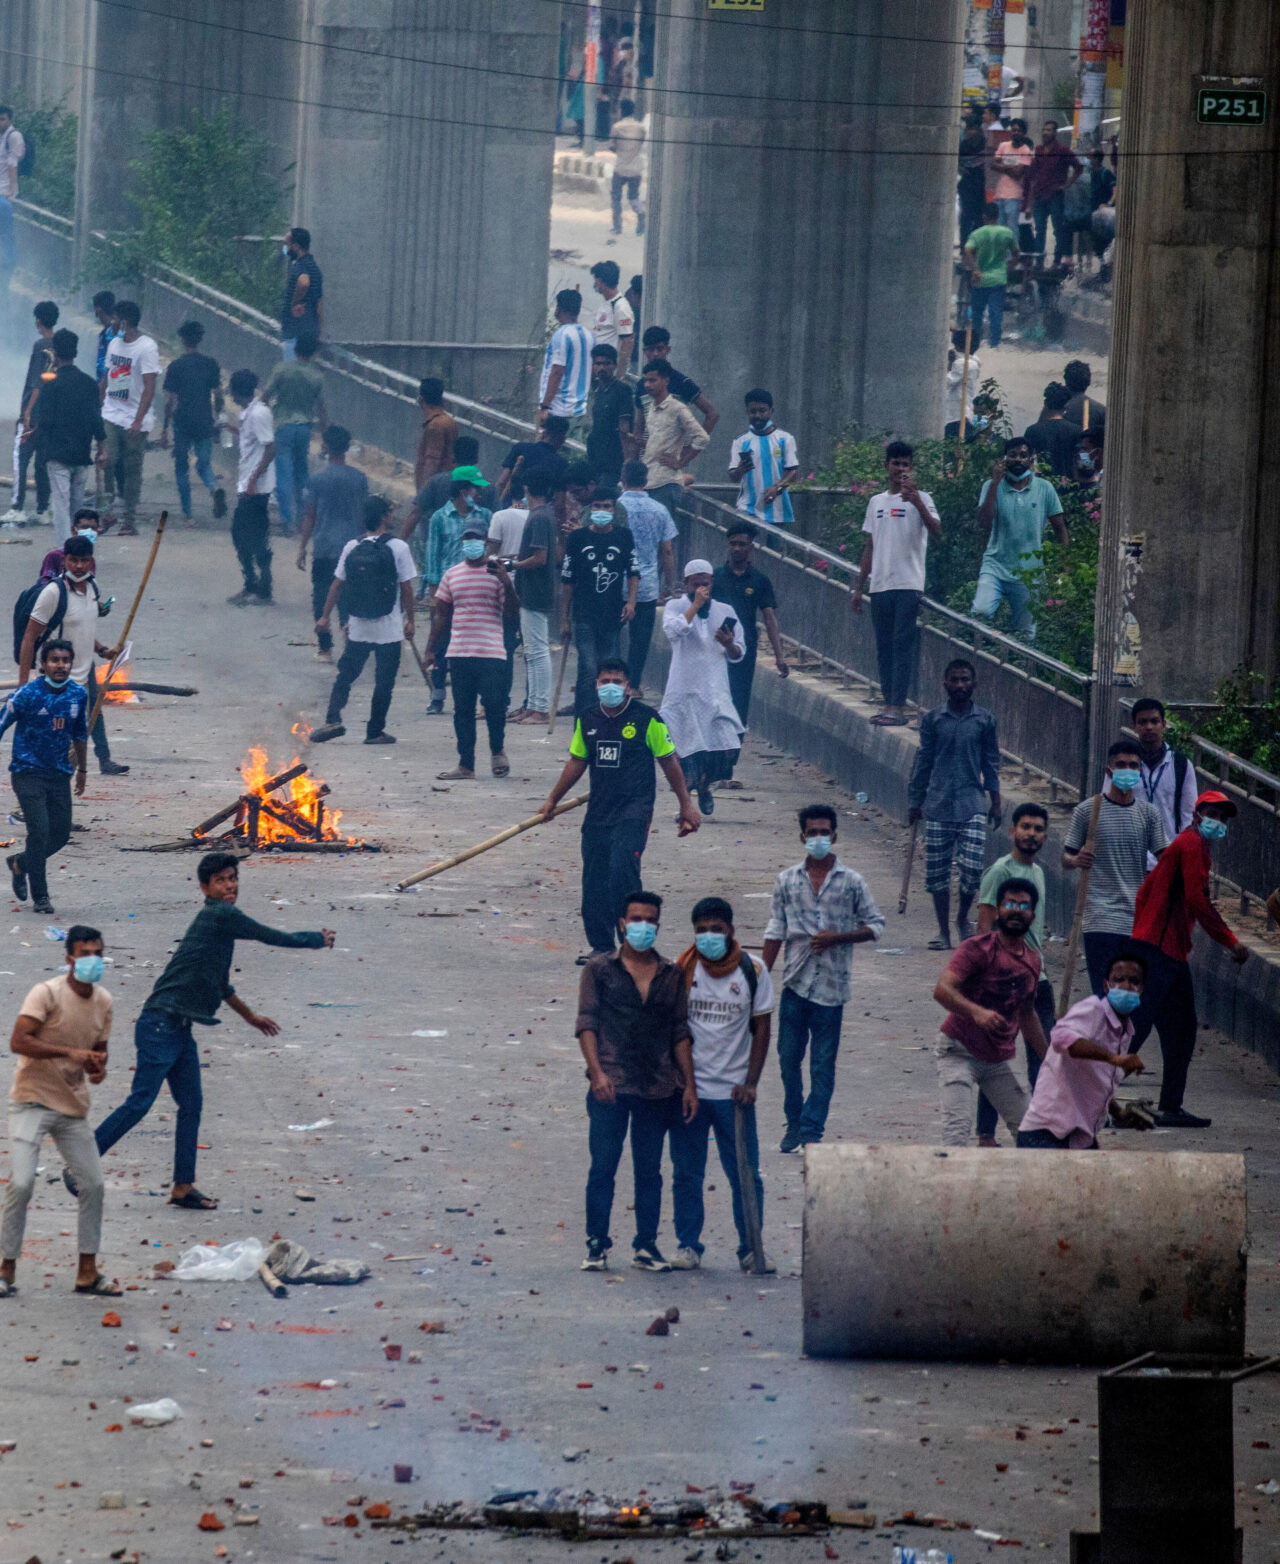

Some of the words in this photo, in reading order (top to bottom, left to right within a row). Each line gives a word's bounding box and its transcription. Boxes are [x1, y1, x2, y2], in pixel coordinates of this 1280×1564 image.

[1202, 97, 1260, 117] P251
[52, 717, 65, 731] 10
[599, 747, 618, 760] 1&1
[689, 1000, 741, 1013] mirates
